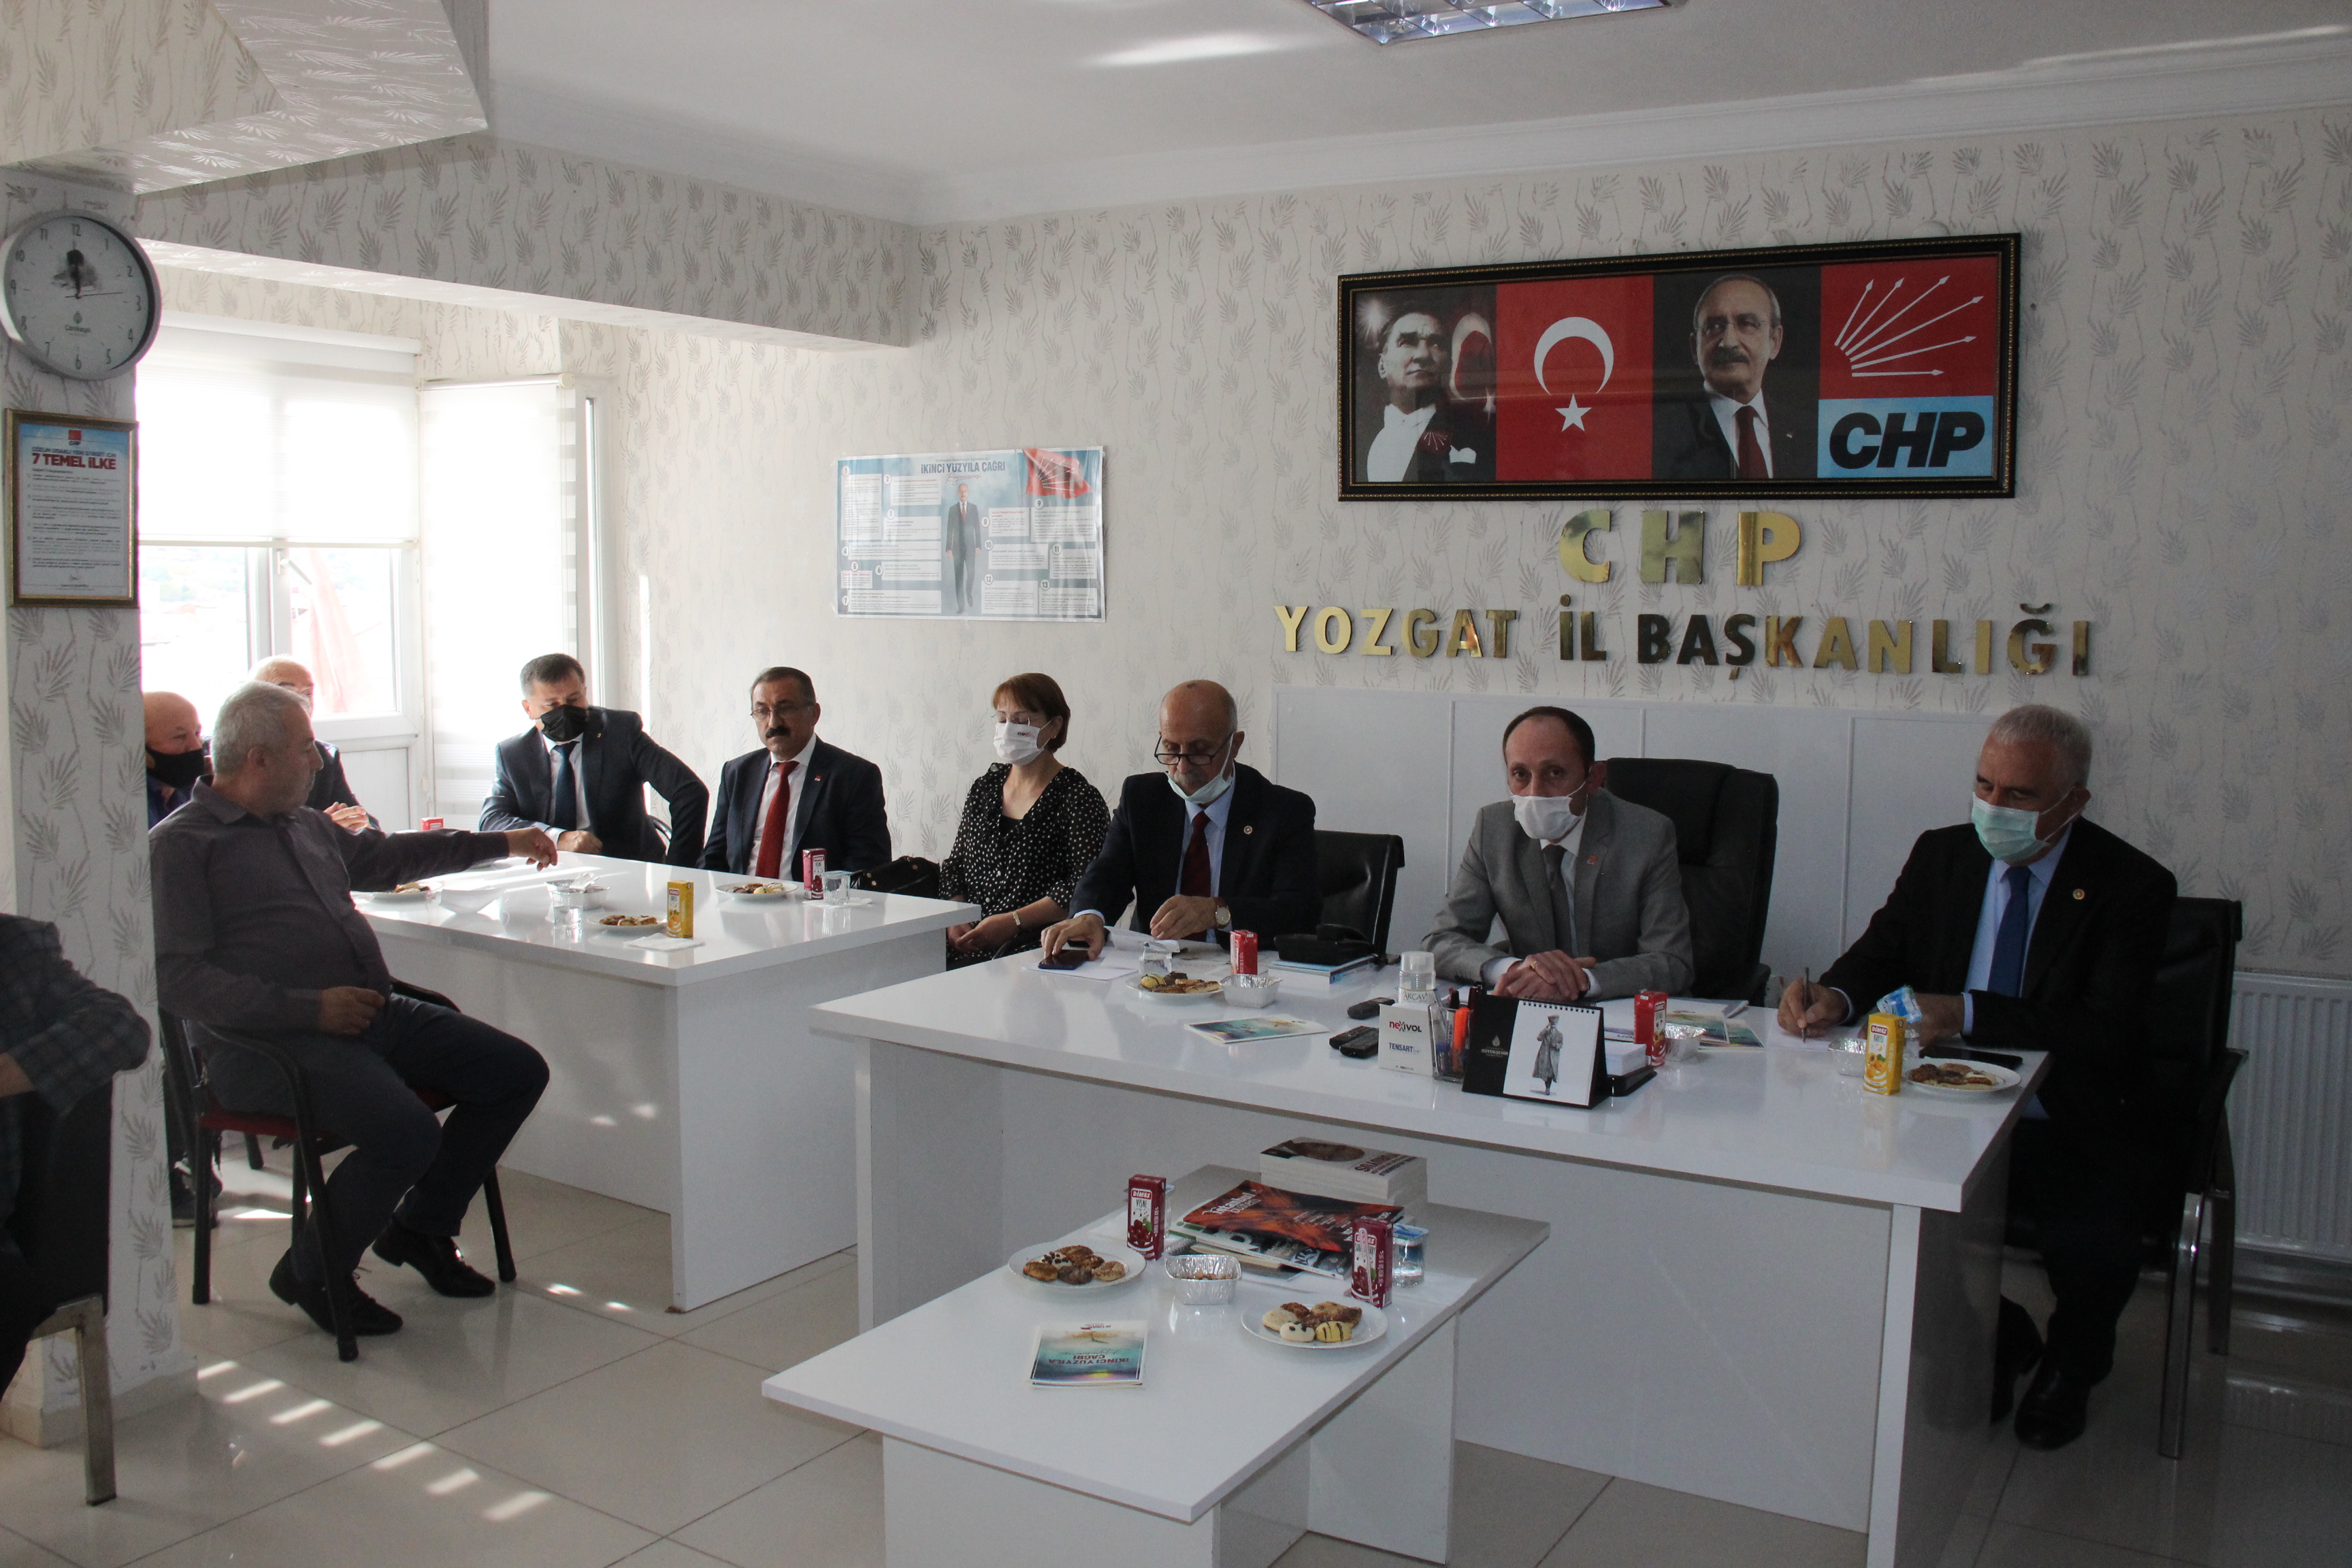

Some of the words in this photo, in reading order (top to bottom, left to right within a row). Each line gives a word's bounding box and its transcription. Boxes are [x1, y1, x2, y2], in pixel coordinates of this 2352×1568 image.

[70, 223, 81, 236] 12
[127, 265, 133, 278] 2
[10, 279, 16, 295] 9
[136, 295, 141, 311] 3
[128, 328, 134, 342] 4
[45, 342, 50, 357] 7
[105, 348, 111, 364] 5
[75, 354, 82, 370] 6
[1828, 410, 1986, 469] CHP
[32, 453, 40, 464] 7
[43, 453, 86, 468] TEMEL
[88, 457, 116, 470] İLKE
[921, 463, 945, 474] İKİNCİ
[946, 461, 980, 473] YÜZYILA
[981, 460, 1005, 472] ÇAĞRI
[1558, 509, 1801, 586] CHP
[1273, 605, 1517, 658] YOZGAT
[1558, 594, 1607, 662] İL
[1637, 602, 2090, 680] BAŞKANLIĞI
[1389, 1043, 1414, 1053] TENSART
[1133, 1190, 1151, 1198] DİMES
[1136, 1198, 1147, 1209] VİŞNE
